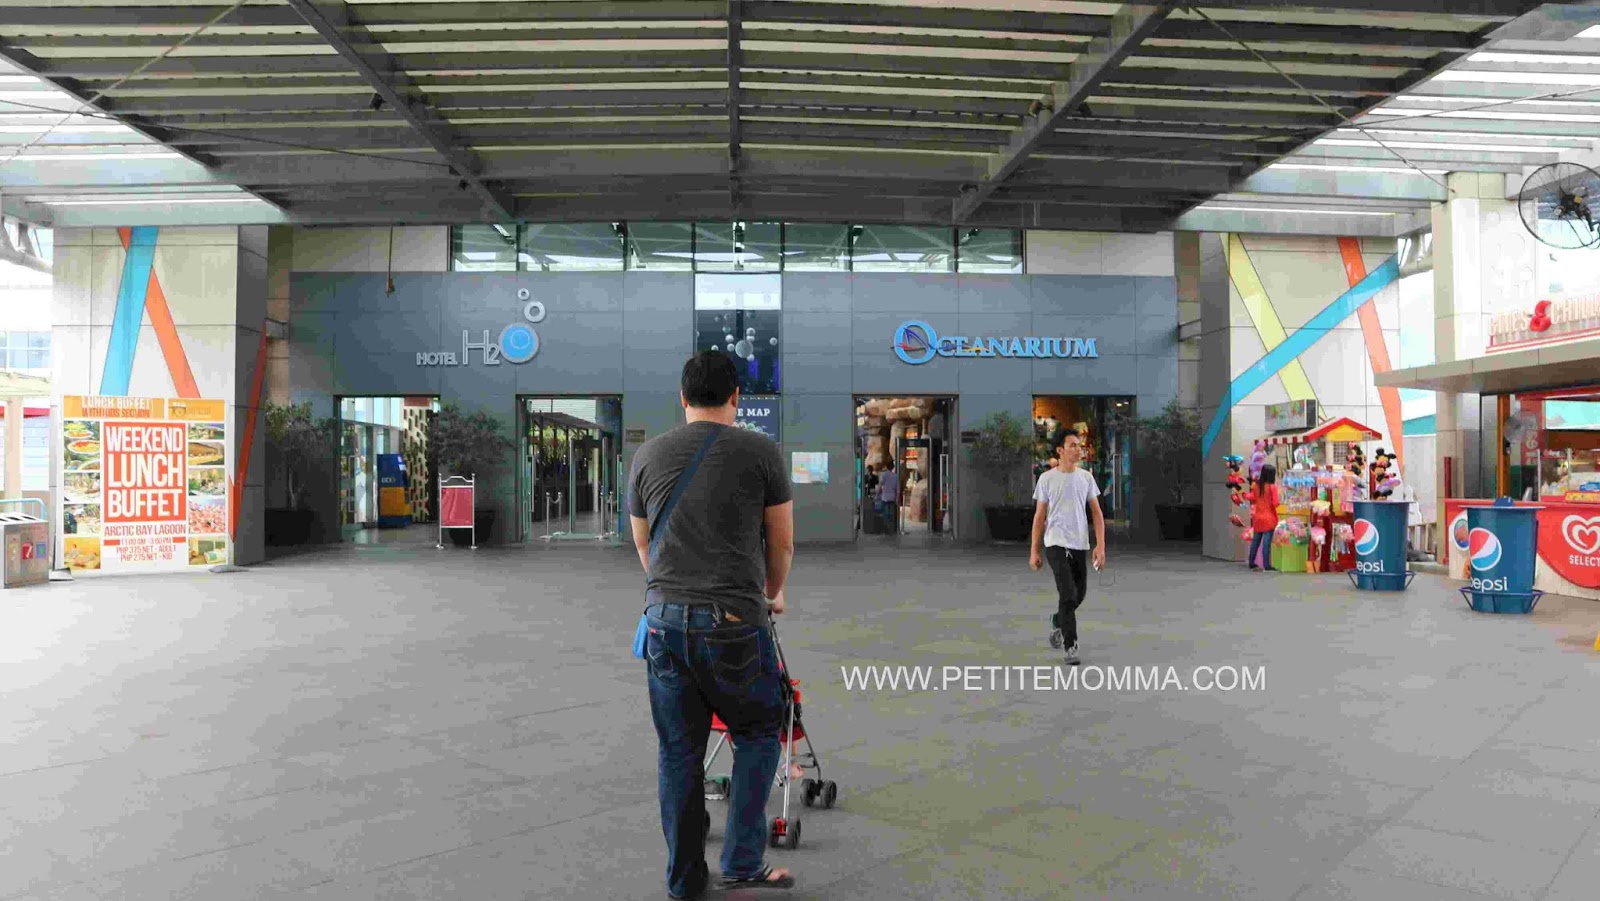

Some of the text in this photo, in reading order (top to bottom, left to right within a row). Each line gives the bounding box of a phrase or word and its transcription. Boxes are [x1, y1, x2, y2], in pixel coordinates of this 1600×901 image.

[1530, 300, 1551, 332] &
[894, 320, 1099, 364] OCEANARIUM
[416, 352, 458, 365] HOTEL
[81, 396, 114, 409] LUNCH
[746, 408, 771, 417] MAP
[105, 425, 183, 452] WEEKEND
[107, 453, 183, 487] LUNCH
[107, 489, 183, 518] BUFFET
[104, 524, 186, 537] ARCTIC BAY LAGOON
[142, 545, 154, 553] NET
[146, 553, 158, 561] NET
[1355, 559, 1384, 575] epsi
